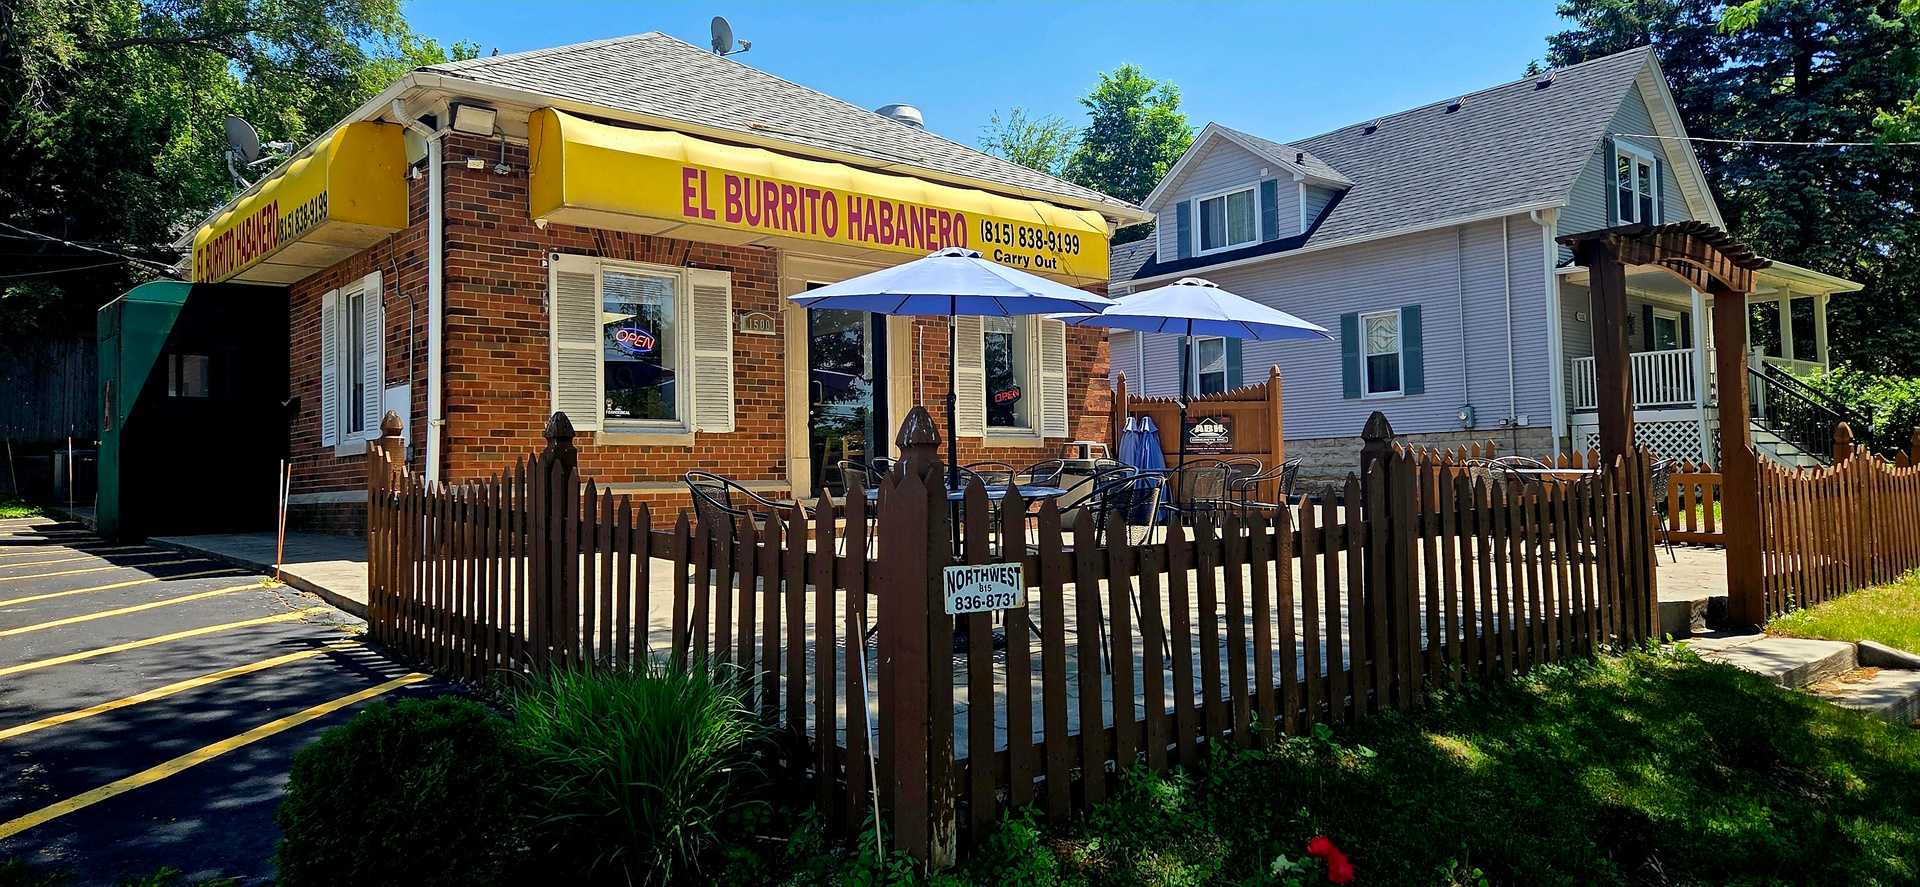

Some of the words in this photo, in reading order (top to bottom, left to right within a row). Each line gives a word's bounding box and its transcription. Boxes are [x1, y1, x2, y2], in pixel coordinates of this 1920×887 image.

[682, 166, 716, 220] EL
[724, 173, 839, 239] BURRITO
[847, 194, 968, 251] HABANERO
[197, 248, 204, 283] EL
[205, 228, 235, 283] BURRITO
[236, 199, 279, 267] HABANERO
[295, 190, 328, 235] 838-9199
[981, 219, 1015, 247] (815)
[1018, 226, 1080, 255] 838-9199
[993, 249, 1030, 268] Carry
[1035, 254, 1057, 270] Out
[615, 329, 655, 350] OPEN
[994, 388, 1020, 405] OPEN
[946, 567, 1021, 597] NORTHWEST
[979, 583, 992, 593] 815
[955, 592, 1017, 611] 836-8731
